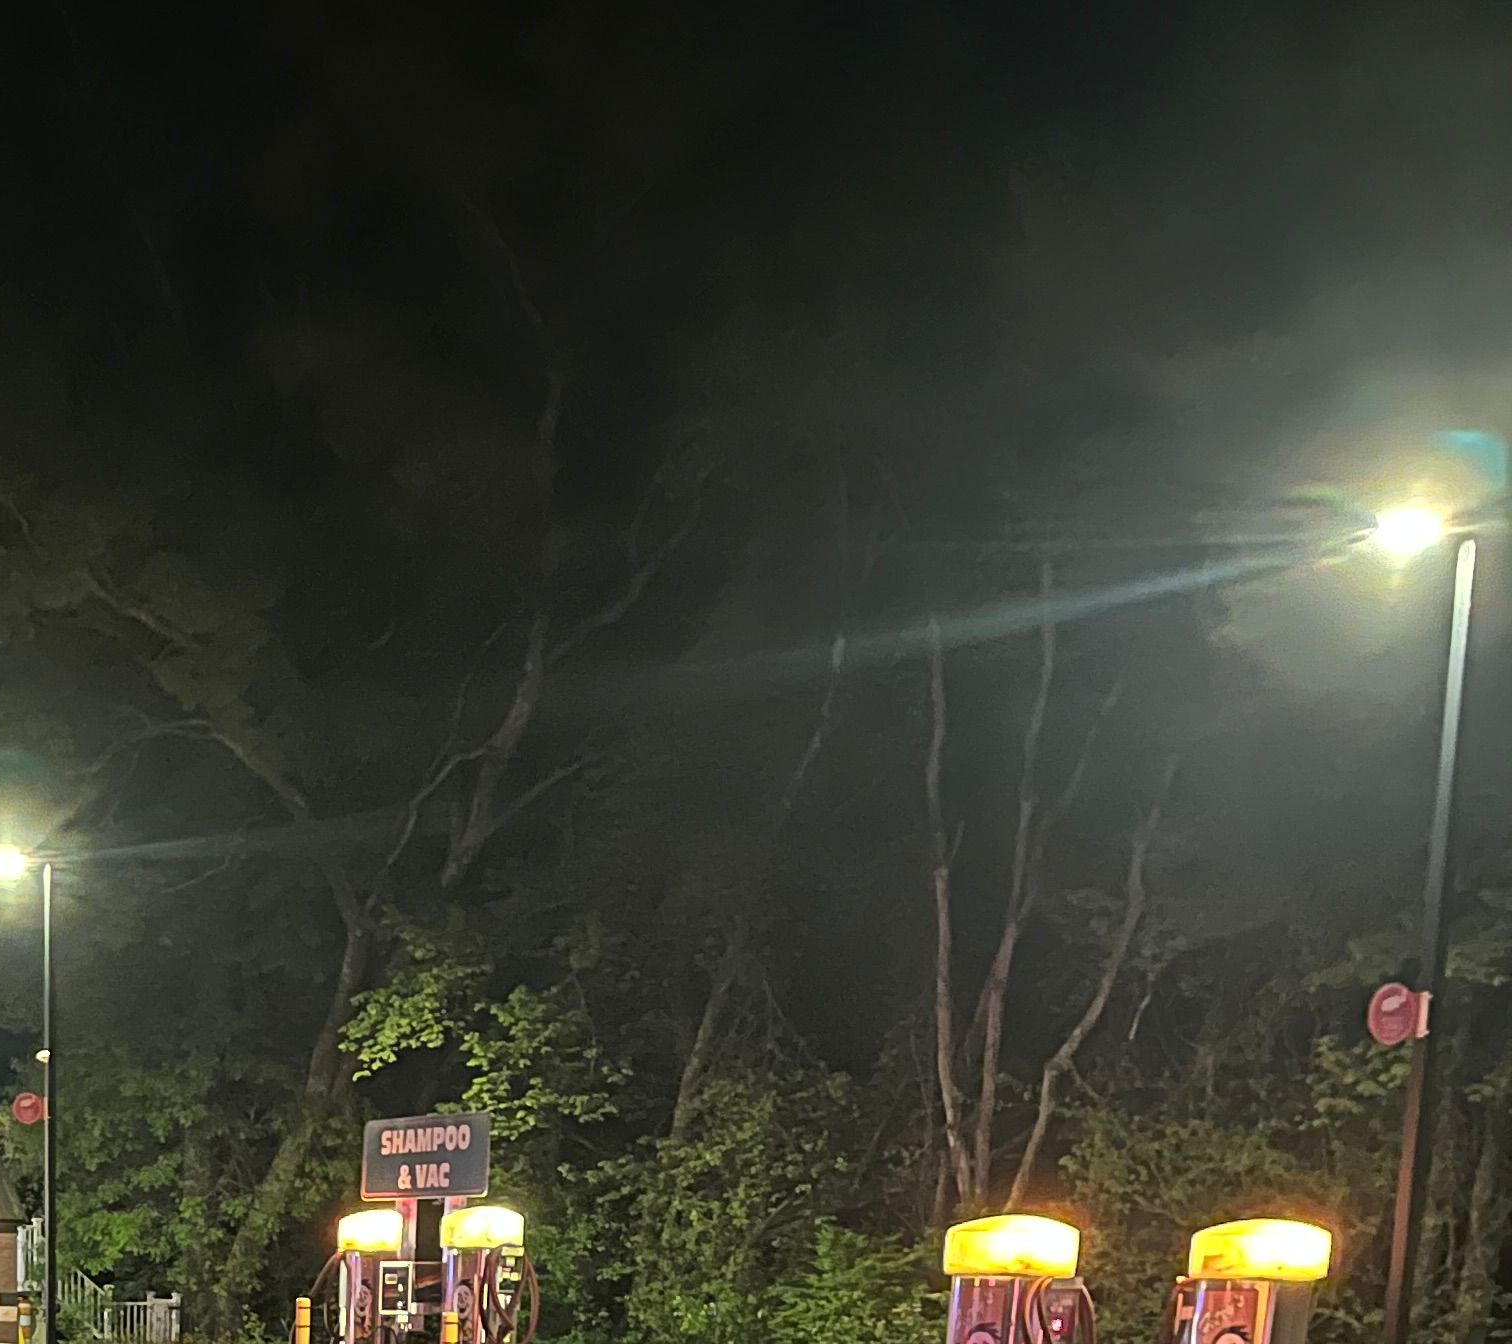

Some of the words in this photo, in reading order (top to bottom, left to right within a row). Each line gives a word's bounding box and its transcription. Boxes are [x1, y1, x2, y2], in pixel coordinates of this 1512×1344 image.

[380, 1124, 471, 1156] SHAMPOO
[397, 1164, 412, 1190] &
[415, 1162, 451, 1189] VAC
